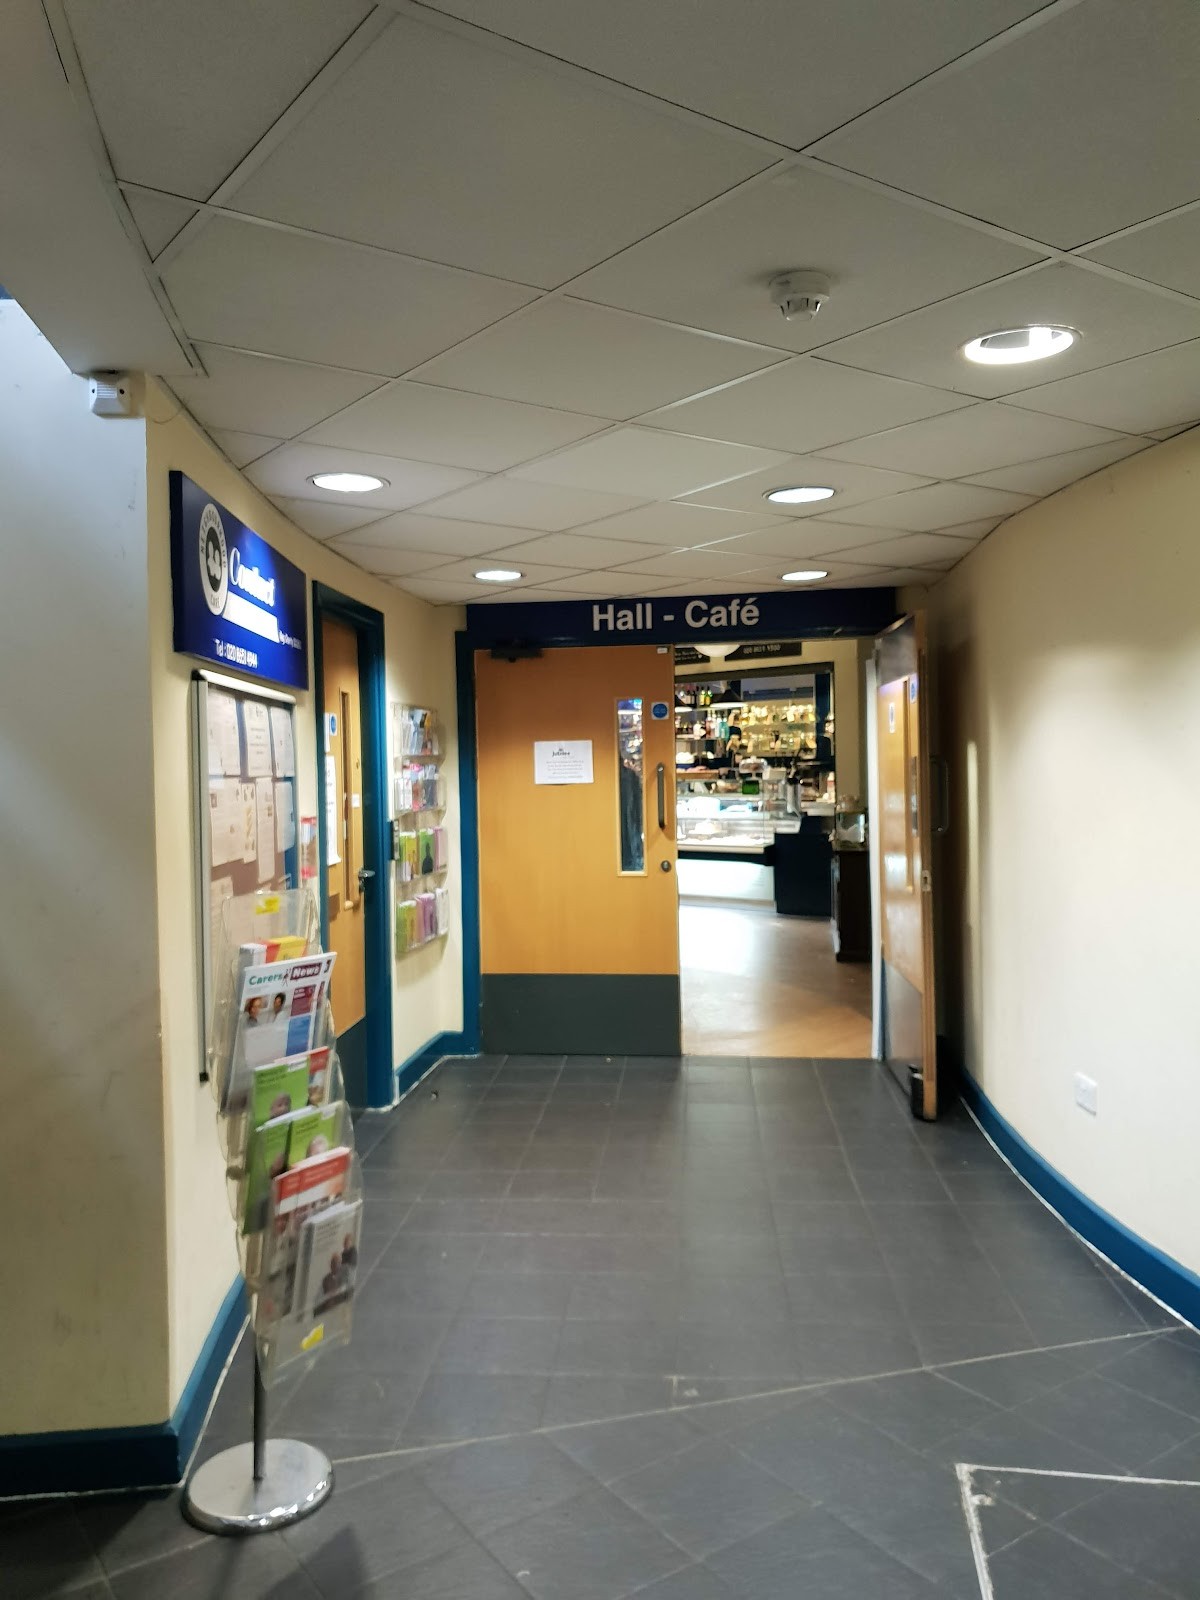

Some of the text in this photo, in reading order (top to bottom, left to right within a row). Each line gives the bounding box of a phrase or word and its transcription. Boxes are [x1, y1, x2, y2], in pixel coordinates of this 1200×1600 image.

[592, 597, 760, 631] Hall - Café
[249, 965, 320, 986] Carers News
